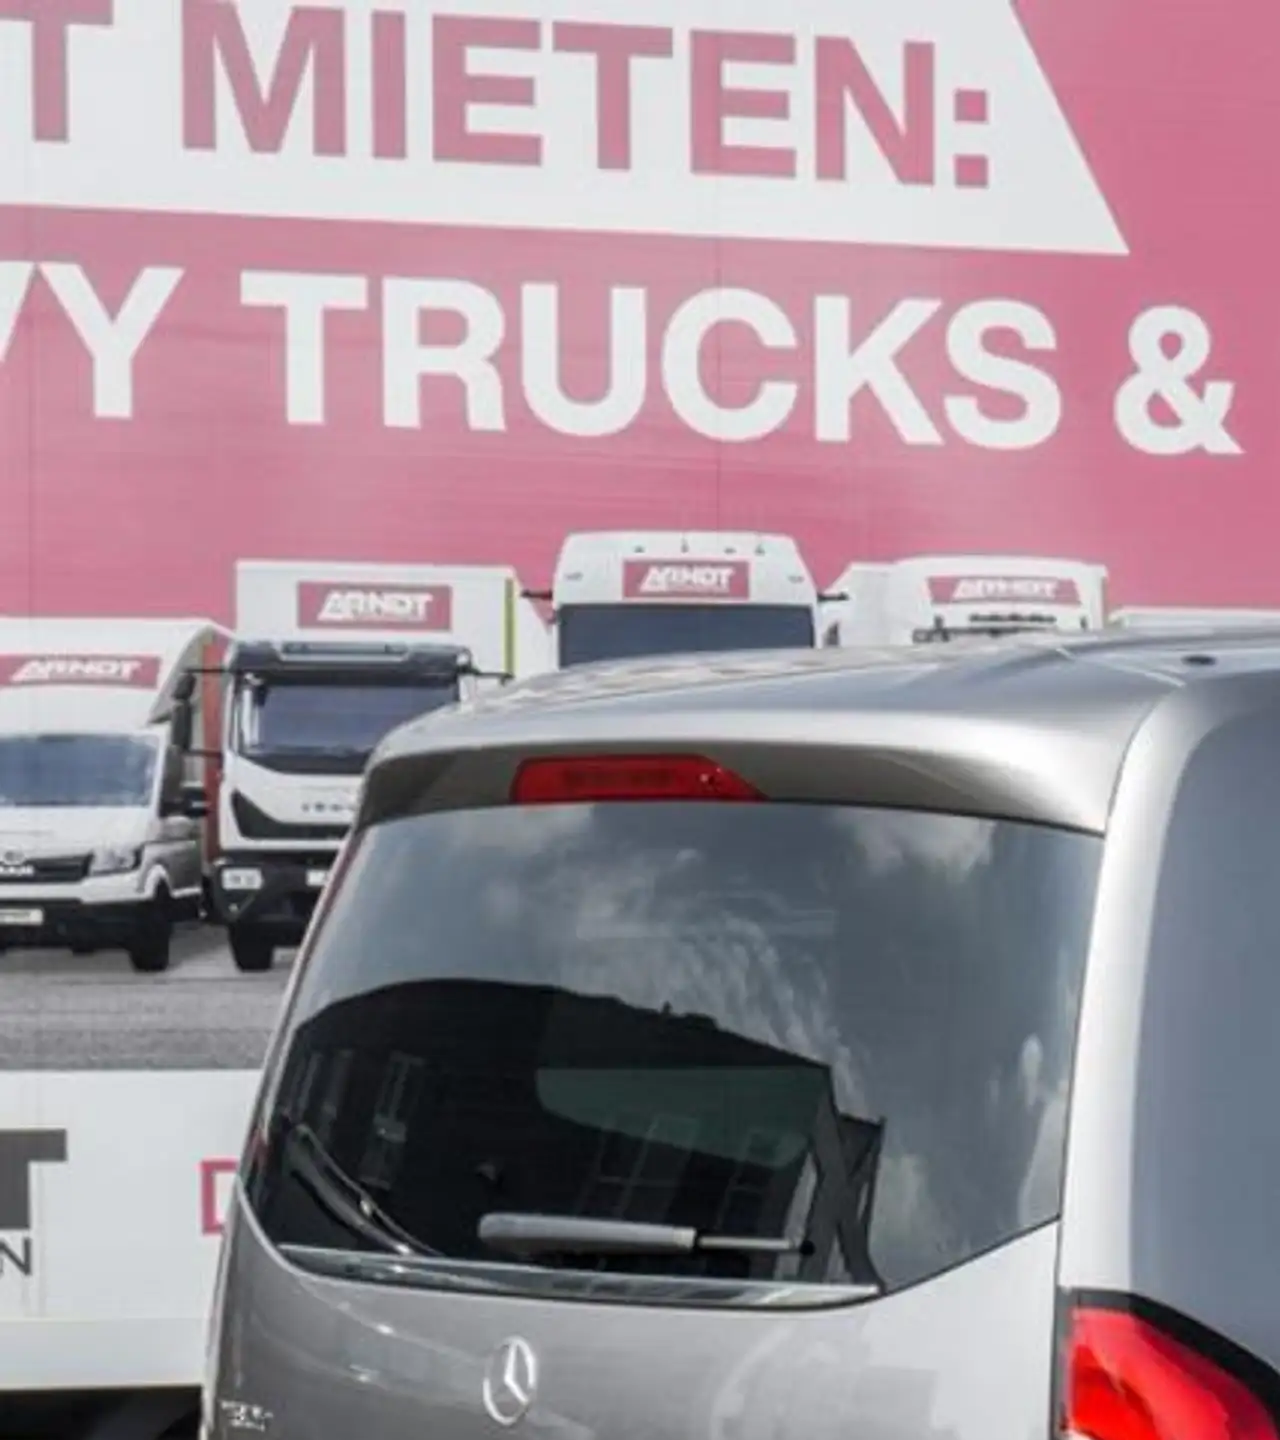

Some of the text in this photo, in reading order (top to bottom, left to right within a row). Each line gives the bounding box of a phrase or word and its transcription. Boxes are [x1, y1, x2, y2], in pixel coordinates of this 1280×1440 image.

[183, 0, 989, 188] MIETEN:
[240, 270, 1063, 450] TRUCKS
[1114, 306, 1244, 455] &
[317, 590, 433, 621] ARNDT
